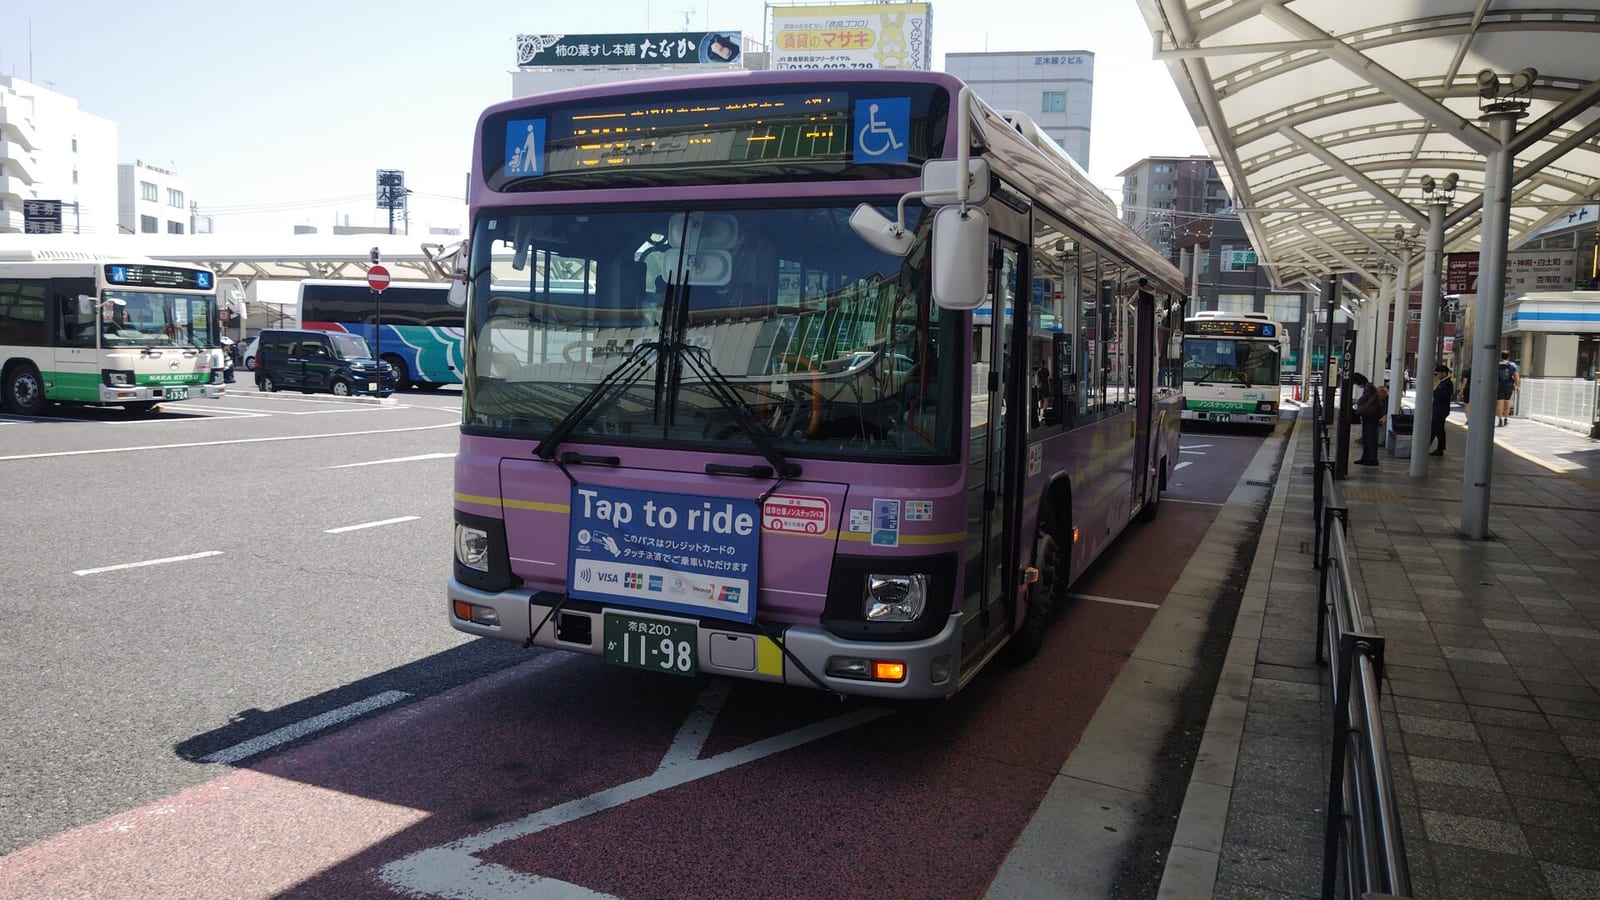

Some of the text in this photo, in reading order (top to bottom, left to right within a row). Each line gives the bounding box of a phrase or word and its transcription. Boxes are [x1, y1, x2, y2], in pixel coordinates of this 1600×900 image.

[555, 38, 696, 59] 柿の葉すし本舗 たなか
[783, 31, 870, 49] 賃貸のマサキ
[1198, 400, 1244, 409] ノンステップバス
[578, 489, 753, 536] Tap to ride
[624, 533, 735, 555] このバスはクレジットカードの
[623, 548, 748, 572] タッチ決済でご乗車いただけます
[597, 572, 619, 583] VISA
[623, 632, 692, 672] 11-98
